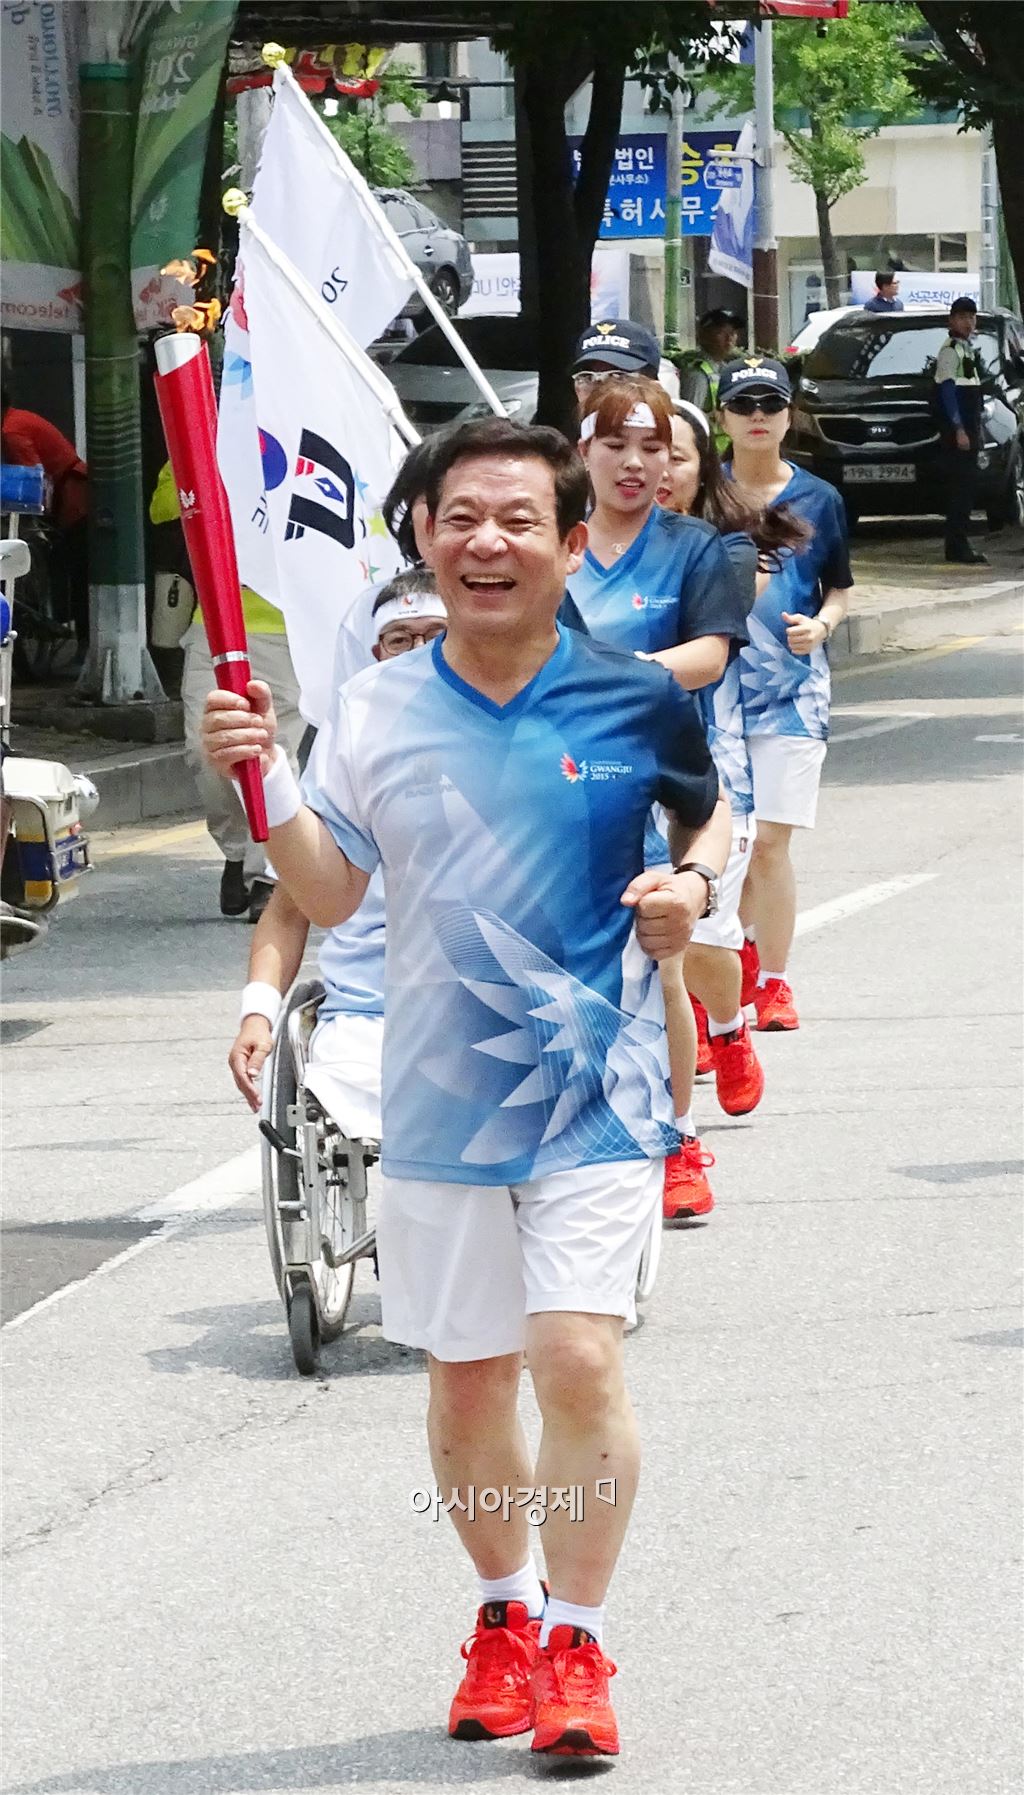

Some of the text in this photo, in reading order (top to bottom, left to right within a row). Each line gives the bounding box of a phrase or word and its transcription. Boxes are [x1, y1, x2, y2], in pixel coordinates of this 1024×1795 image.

[582, 335, 631, 350] POLICE
[731, 367, 778, 383] POLICE
[590, 765, 632, 774] GWANGJU
[590, 772, 609, 780] 2015
